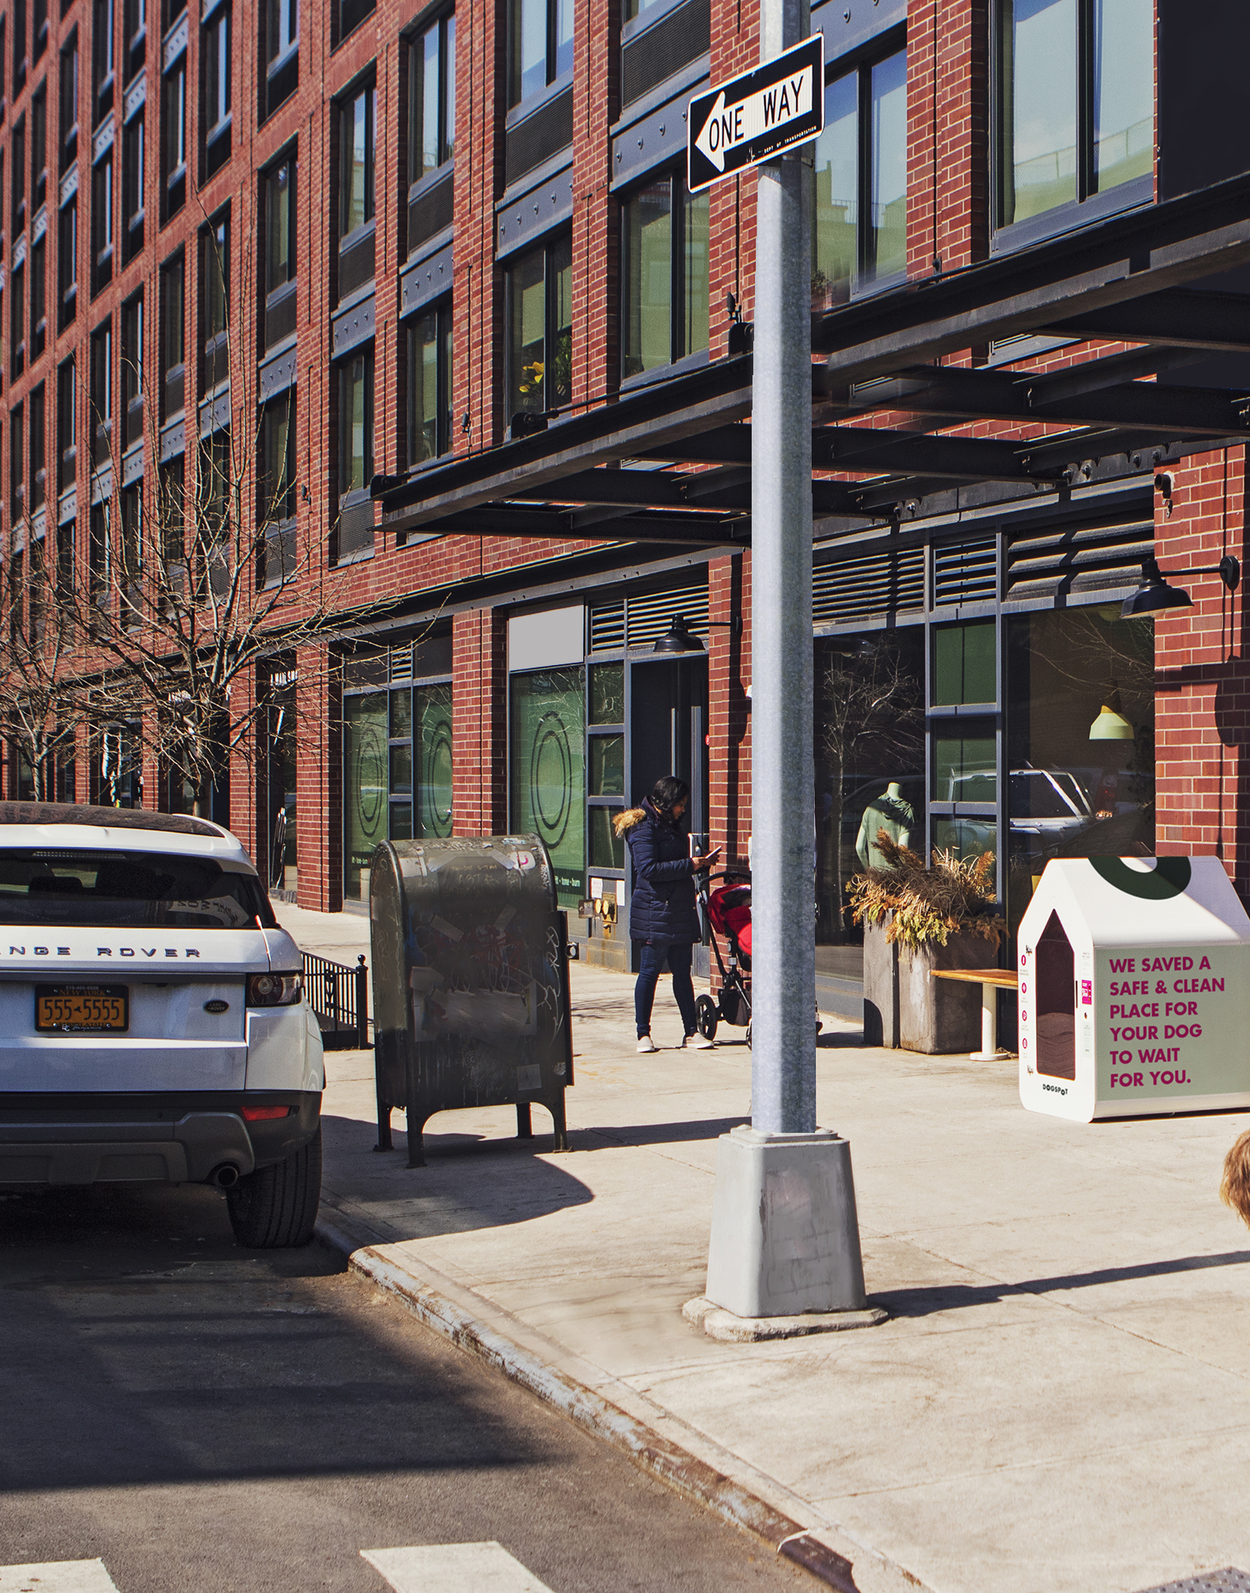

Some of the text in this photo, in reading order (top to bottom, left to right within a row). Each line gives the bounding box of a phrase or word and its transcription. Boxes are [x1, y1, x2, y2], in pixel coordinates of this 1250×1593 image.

[709, 75, 804, 153] ONE WAY
[0, 946, 201, 958] NGE ROVER
[1109, 958, 1136, 973] WE
[1141, 956, 1194, 973] SAVED
[1199, 955, 1212, 970] A
[1110, 980, 1149, 996] SAFE
[1154, 979, 1168, 994] &
[1172, 977, 1225, 993] CLEAN
[1110, 1001, 1198, 1019] PLACE FOR
[1110, 1025, 1159, 1042] YOUR
[1164, 1024, 1202, 1039] DOG
[1110, 1048, 1181, 1065] TO WAIT
[1110, 1069, 1192, 1088] FOR YOU.
[1042, 1083, 1069, 1096] DOGSPOT
